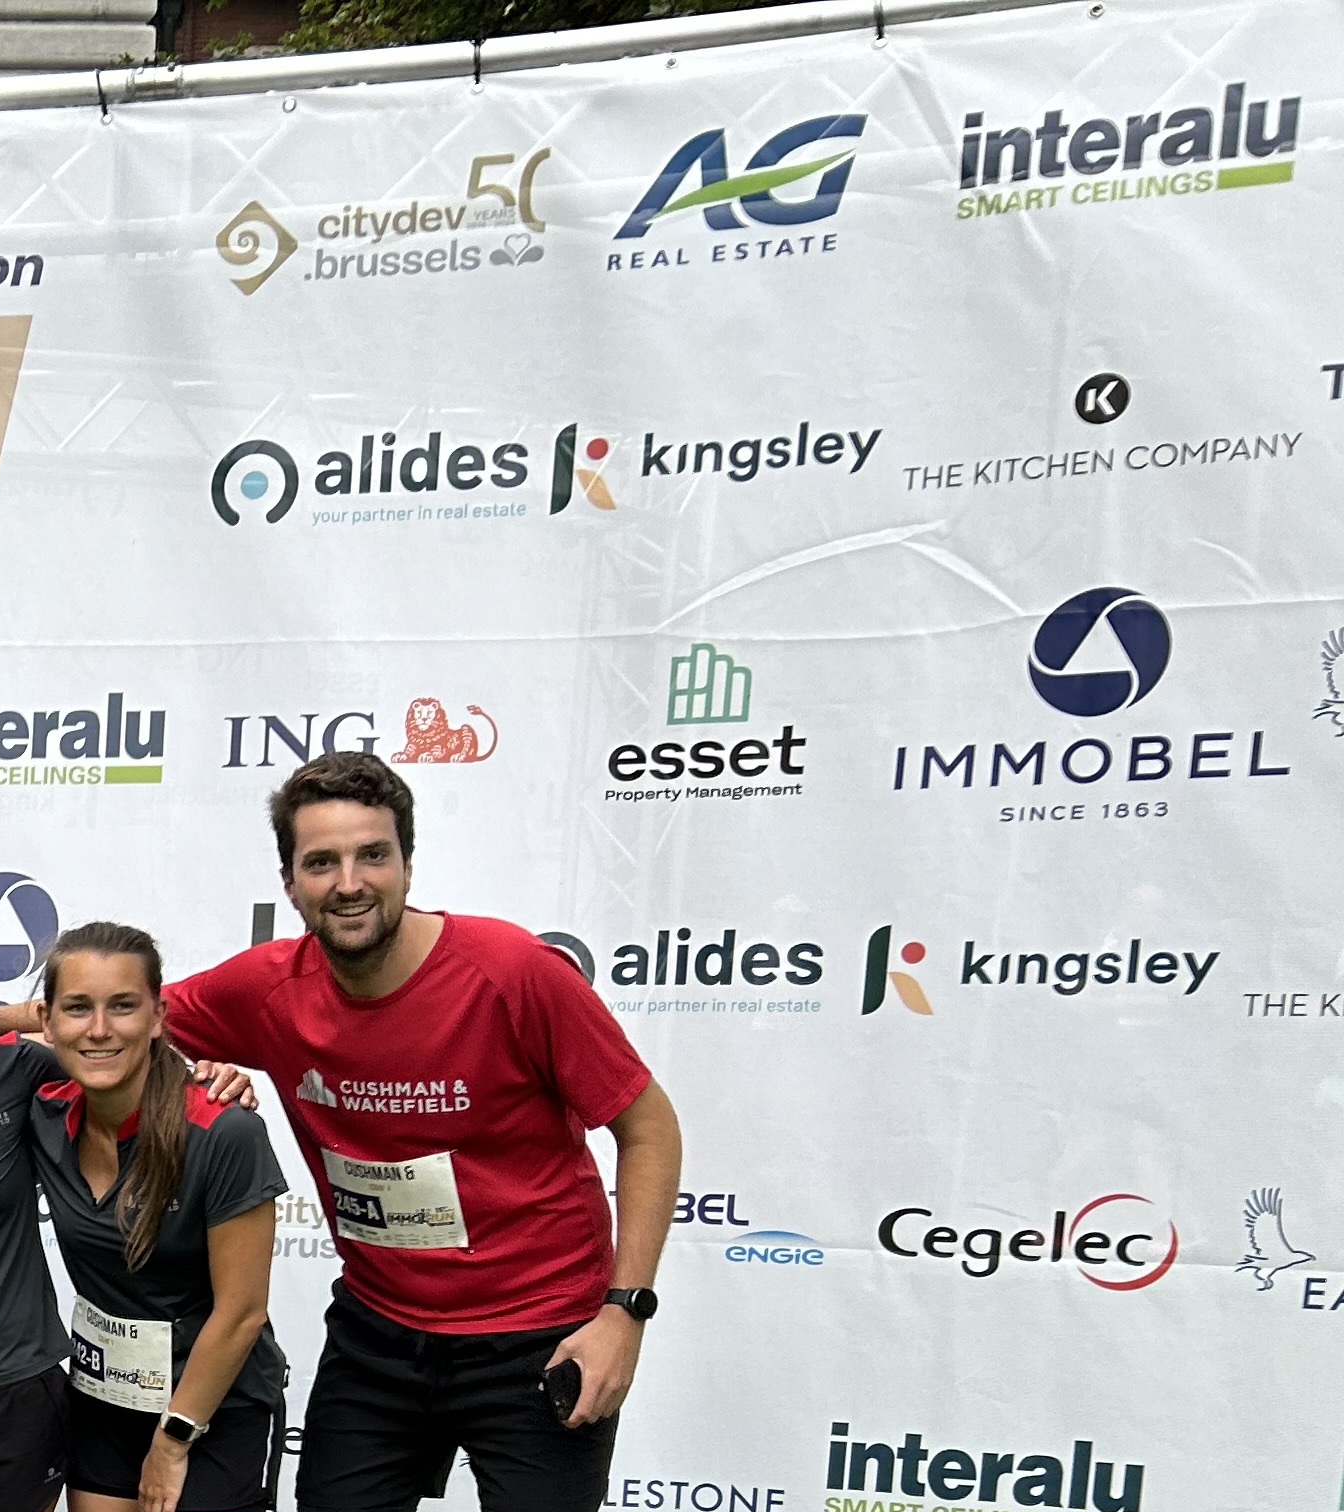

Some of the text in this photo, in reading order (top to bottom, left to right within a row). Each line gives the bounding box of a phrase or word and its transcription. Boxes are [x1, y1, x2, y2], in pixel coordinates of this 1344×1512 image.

[959, 81, 1302, 190] interalu
[612, 112, 869, 241] AG
[955, 170, 1215, 220] SMART CEILINGS
[317, 200, 467, 244] citydev
[303, 238, 481, 281] .brussels
[606, 232, 841, 272] REAL ESTATE
[314, 431, 529, 496] alides
[641, 423, 883, 483] kingsley
[902, 432, 1304, 491] THE KITCHEN COMPANY
[312, 501, 527, 527] your partner in real estate
[222, 711, 381, 769] ING
[608, 725, 807, 783] esset
[893, 730, 1291, 790] IMMOBEL
[604, 782, 803, 803] Property Management
[999, 801, 1170, 823] SINCE 1863
[614, 929, 824, 986] alides
[960, 938, 1220, 996] kingsley
[609, 998, 822, 1016] your partner in real estate
[1243, 993, 1308, 1017] THE
[339, 1079, 468, 1098] CUSHMAN &
[341, 1095, 471, 1114] WAKEFIELD
[344, 1160, 402, 1181] CUSHMAN
[333, 1191, 381, 1221] 245-A
[878, 1207, 1153, 1278] Cegelec
